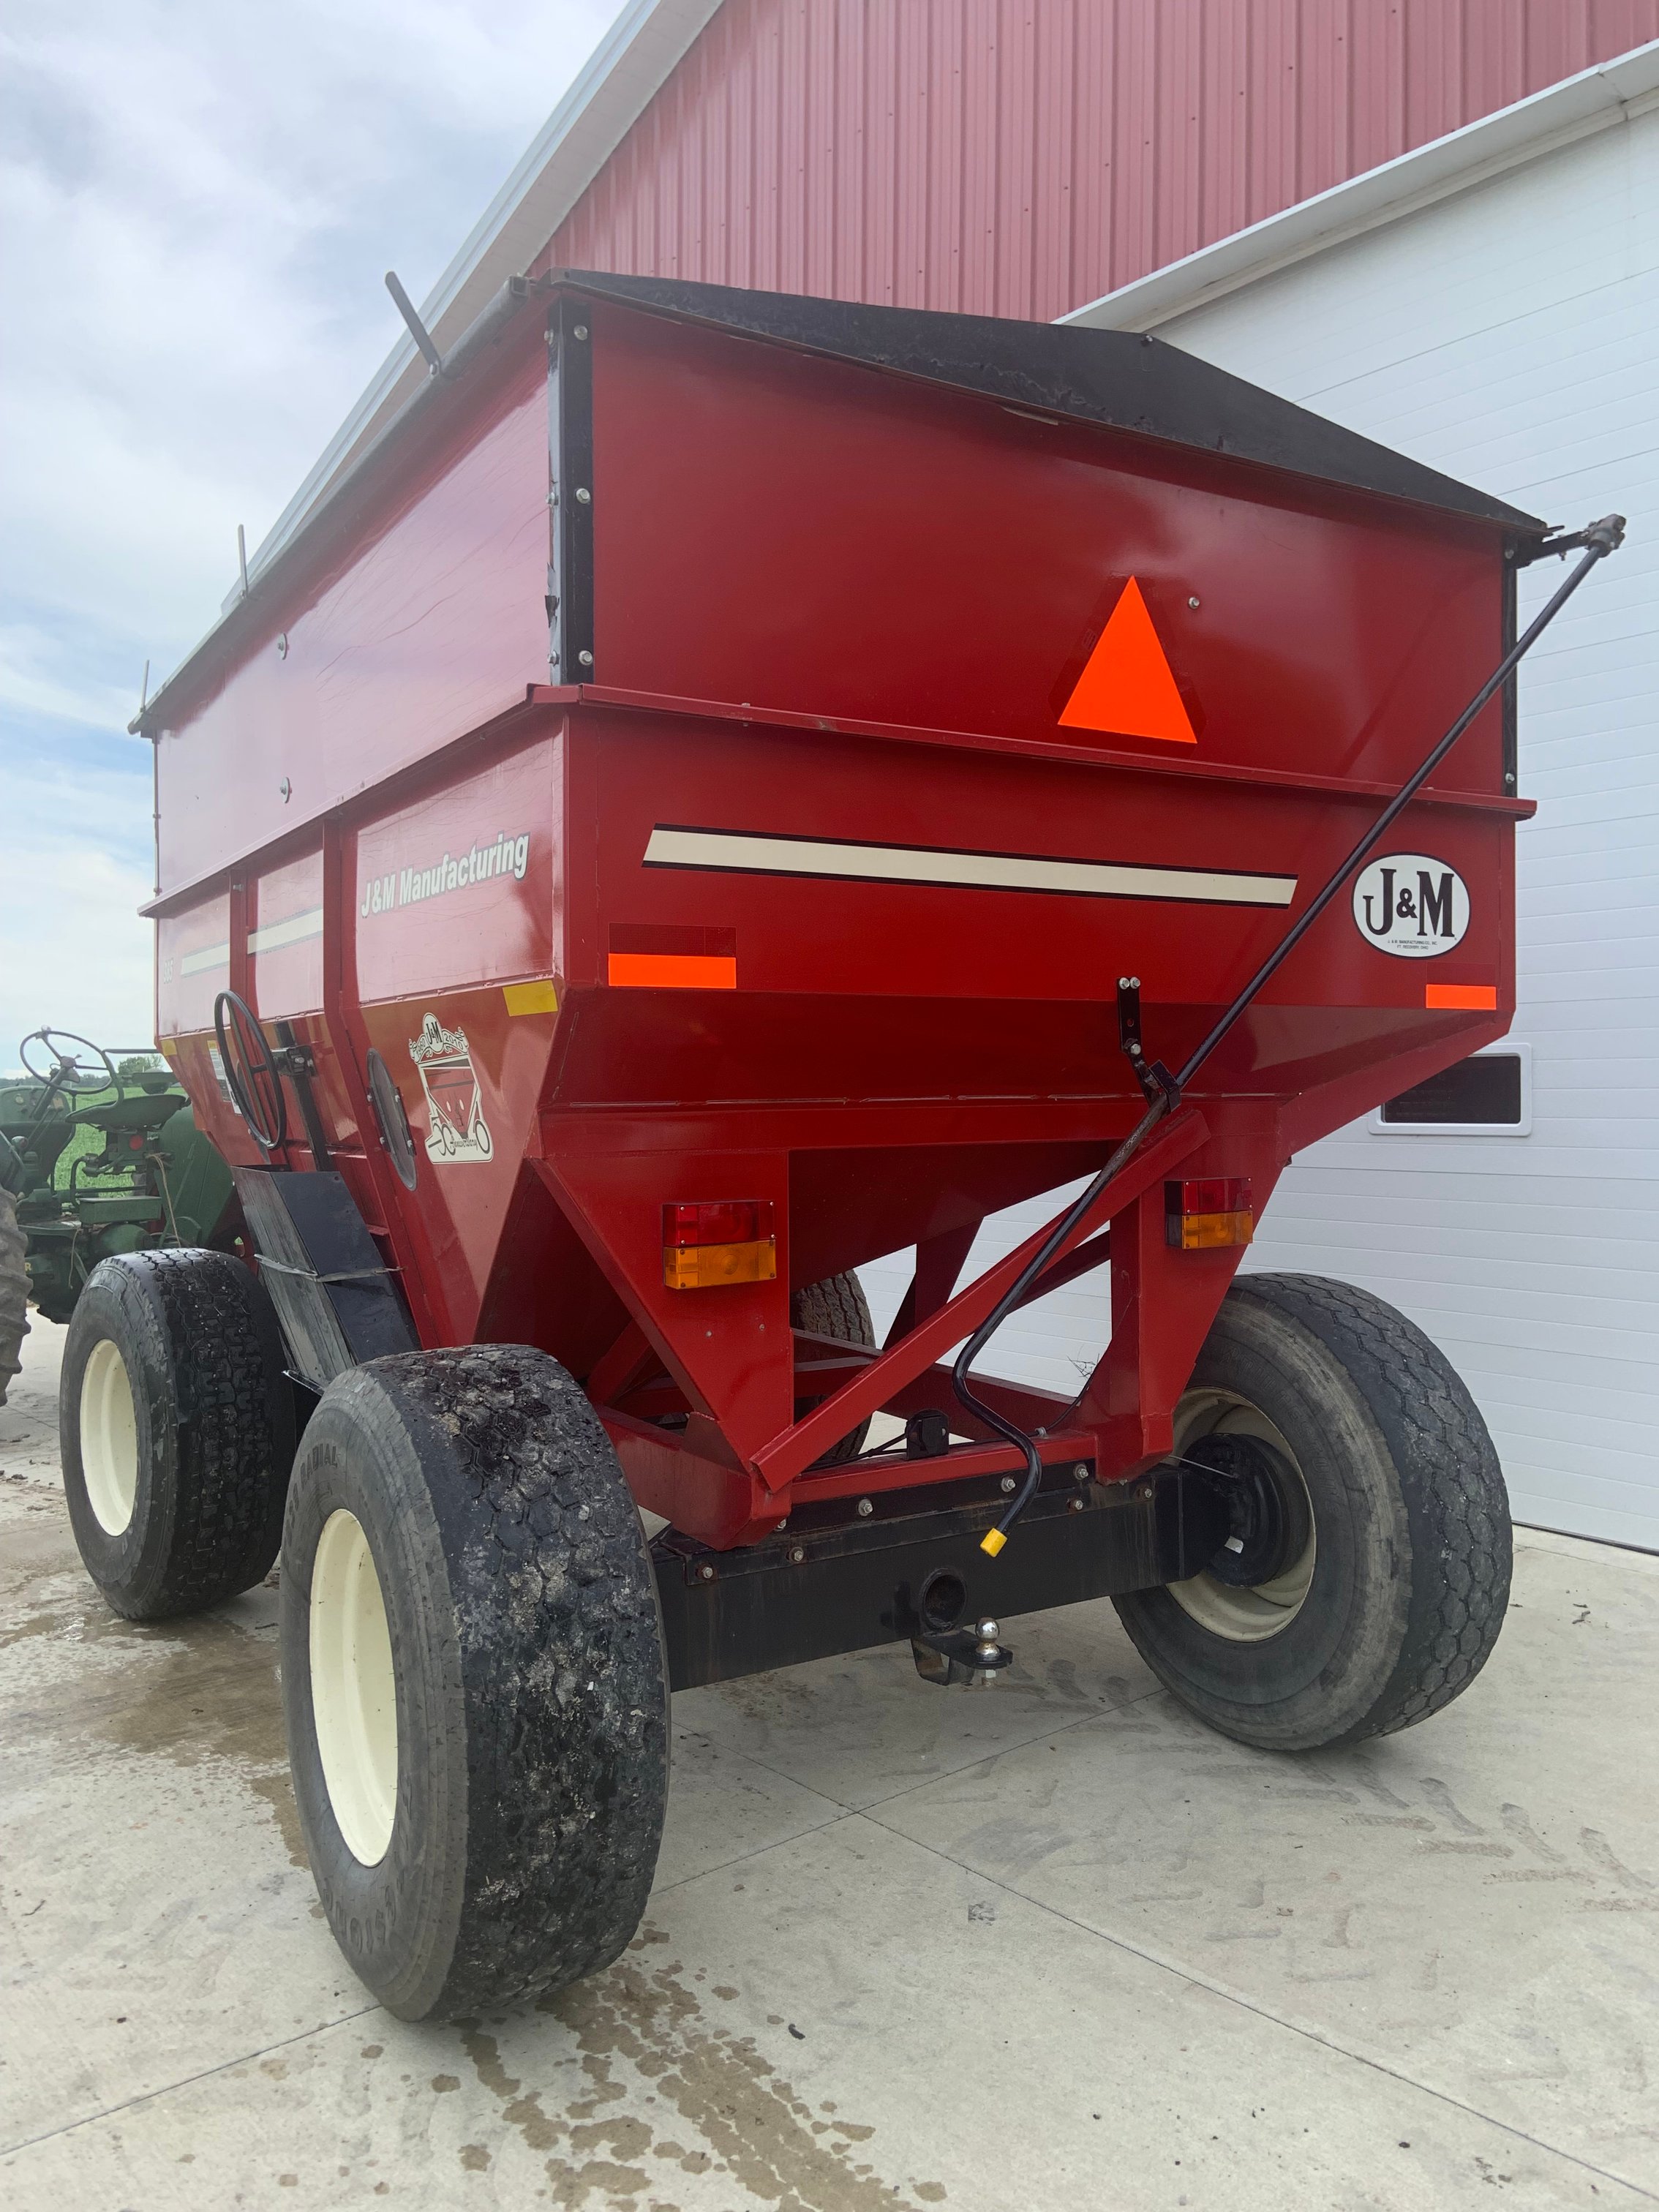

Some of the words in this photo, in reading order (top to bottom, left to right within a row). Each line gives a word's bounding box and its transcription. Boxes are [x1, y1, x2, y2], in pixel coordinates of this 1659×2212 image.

[361, 870, 396, 918] J&M
[399, 830, 531, 907] Manufacturing
[1363, 868, 1455, 937] J&M
[416, 1038, 426, 1058] 1960
[443, 1033, 464, 1050] 2010
[426, 1021, 443, 1045] J&M
